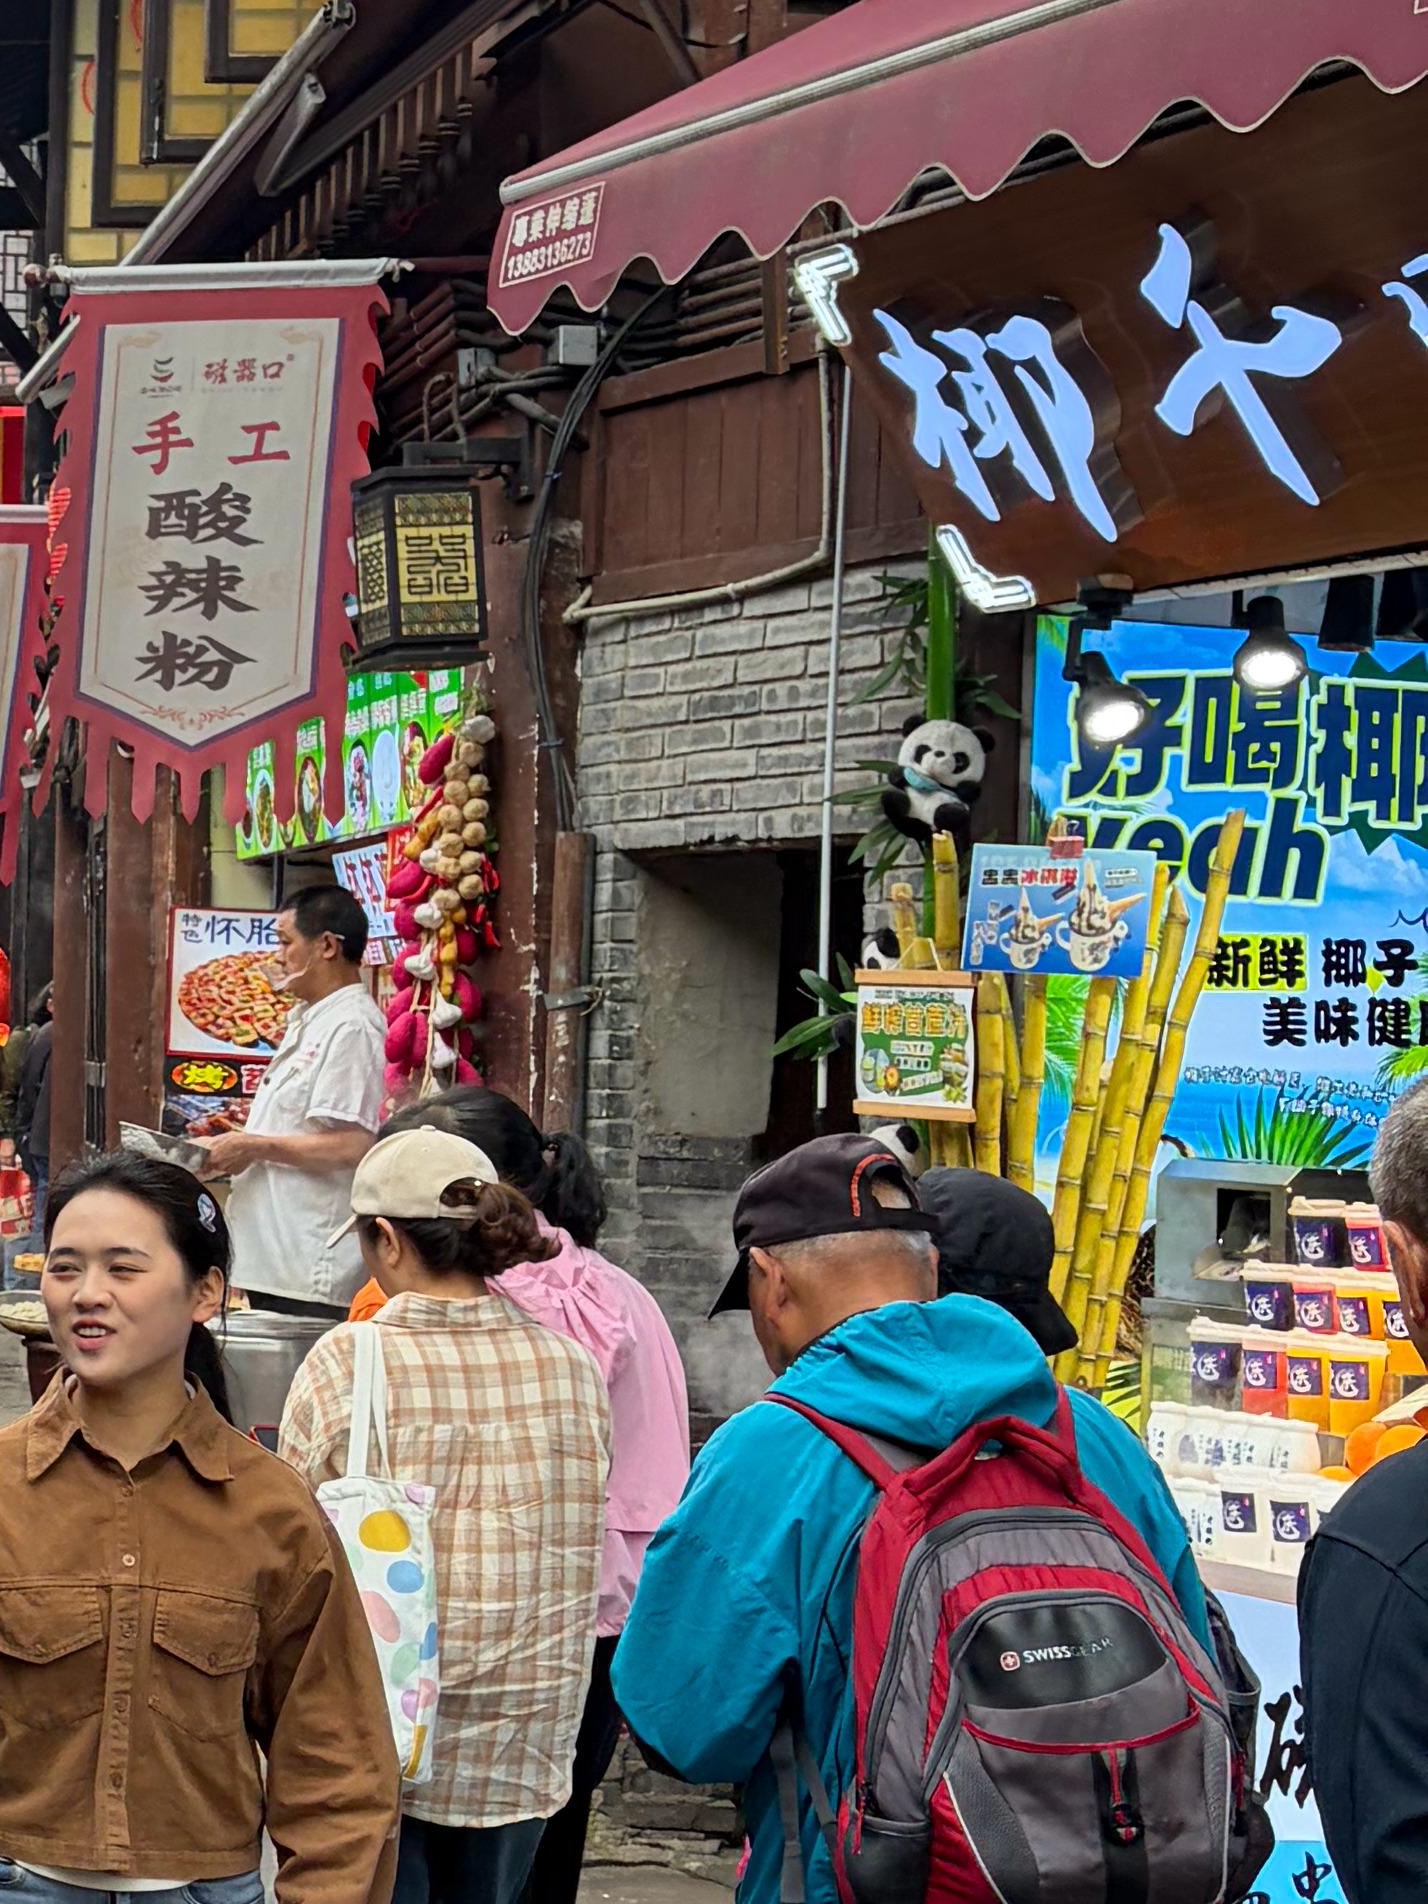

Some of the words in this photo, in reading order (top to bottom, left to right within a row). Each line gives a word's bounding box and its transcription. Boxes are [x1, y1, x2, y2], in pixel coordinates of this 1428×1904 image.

[507, 231, 592, 280] 13883136273
[131, 410, 291, 476] 手工
[133, 481, 265, 693] 酸辣粉
[181, 912, 203, 944] 特色
[204, 914, 281, 947] 怀胎
[1206, 935, 1307, 988] 新鲜
[1320, 937, 1420, 989] 椰子
[1022, 1637, 1114, 1664] SWISSGEAR
